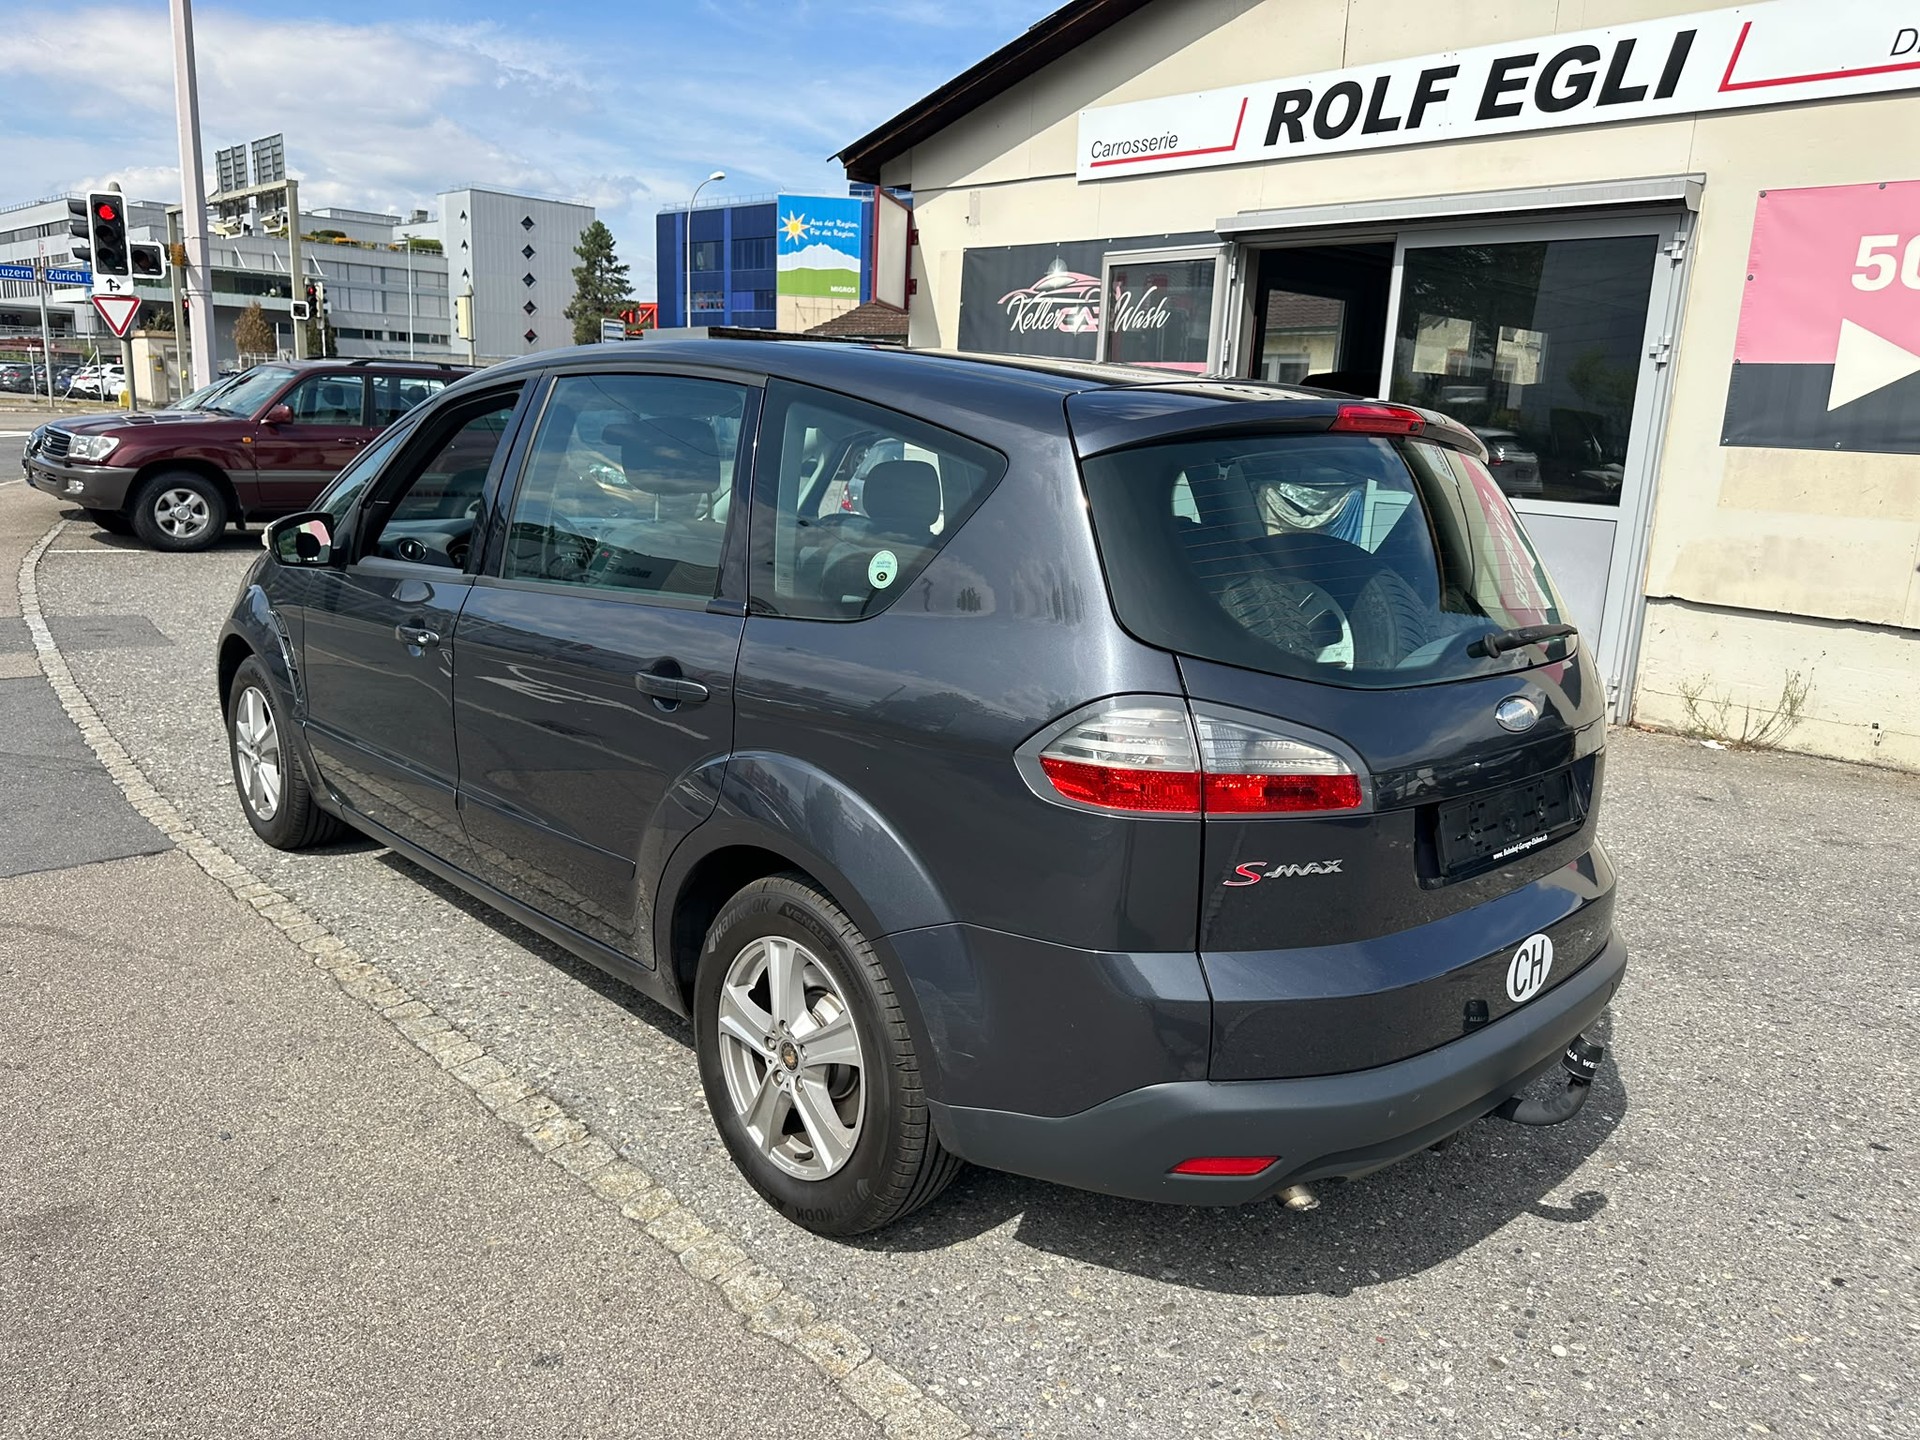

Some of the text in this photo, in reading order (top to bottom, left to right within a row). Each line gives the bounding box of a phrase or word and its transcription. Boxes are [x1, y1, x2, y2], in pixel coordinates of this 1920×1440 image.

[1889, 28, 1920, 56] D
[1264, 29, 1697, 147] ROLF EGLI
[1091, 131, 1178, 158] Carrosserie
[810, 218, 823, 226] Aus
[824, 219, 835, 227] der
[0, 268, 33, 279] uzern
[48, 269, 82, 282] Zürich
[830, 285, 856, 293] MIGROS
[1007, 292, 1066, 334] Keller
[1114, 286, 1171, 333] Wash
[1222, 859, 1343, 887] S-MAX
[1513, 939, 1545, 997] CH
